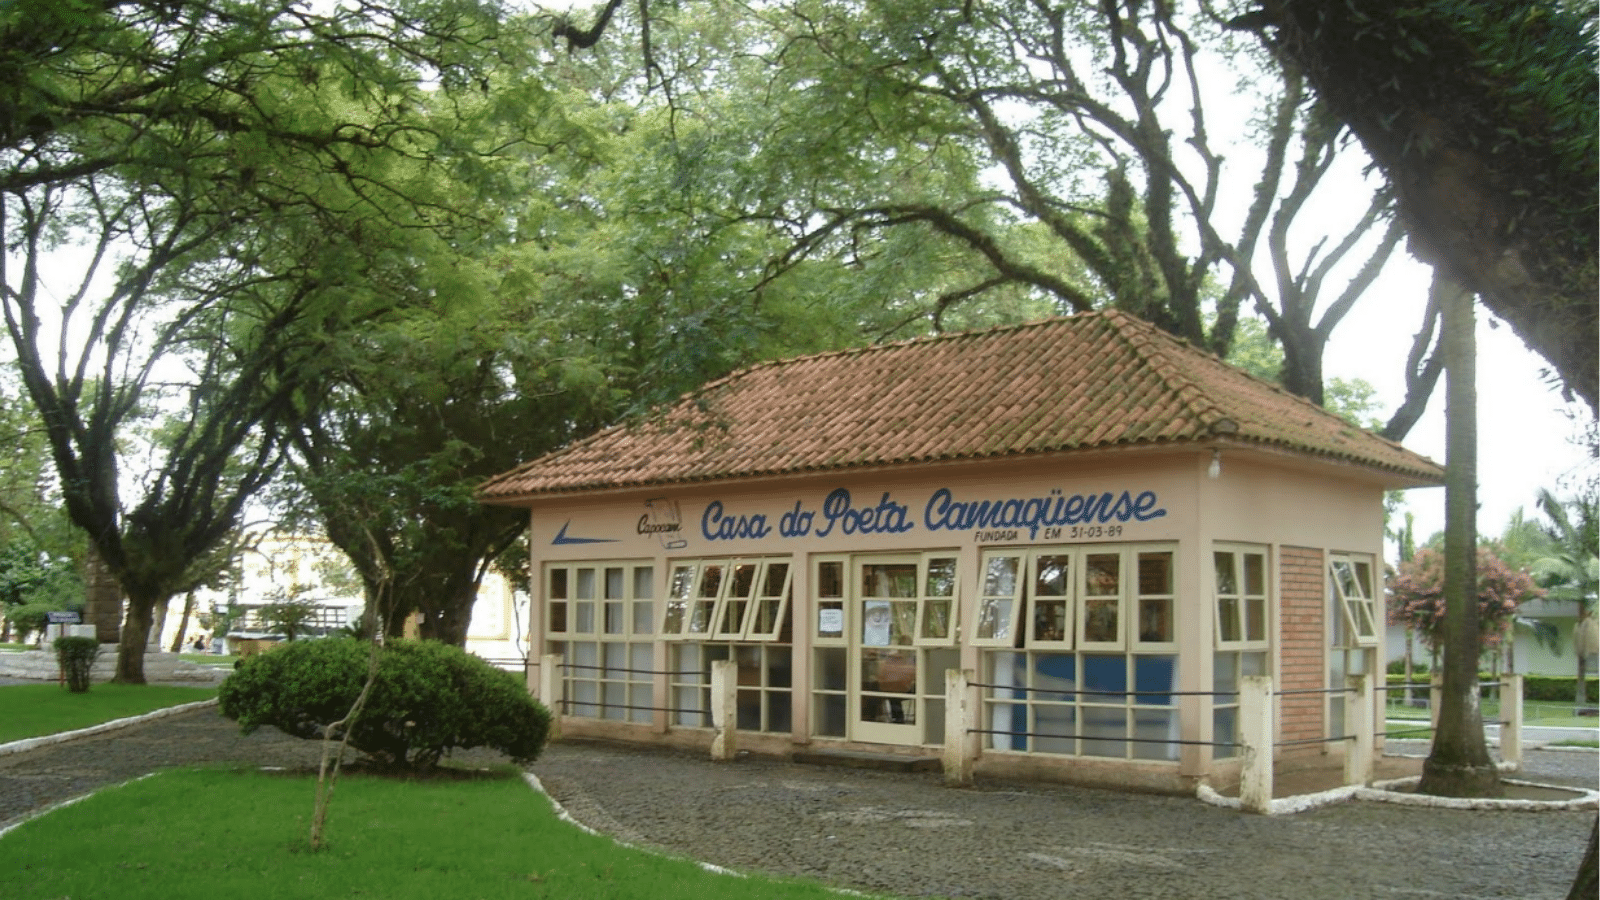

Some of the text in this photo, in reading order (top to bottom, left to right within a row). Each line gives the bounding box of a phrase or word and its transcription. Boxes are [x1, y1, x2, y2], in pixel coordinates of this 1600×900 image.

[701, 487, 1167, 541] Casa do Poeta Camaqüense
[974, 525, 1123, 542] FUNDADA EM 31-03-89
